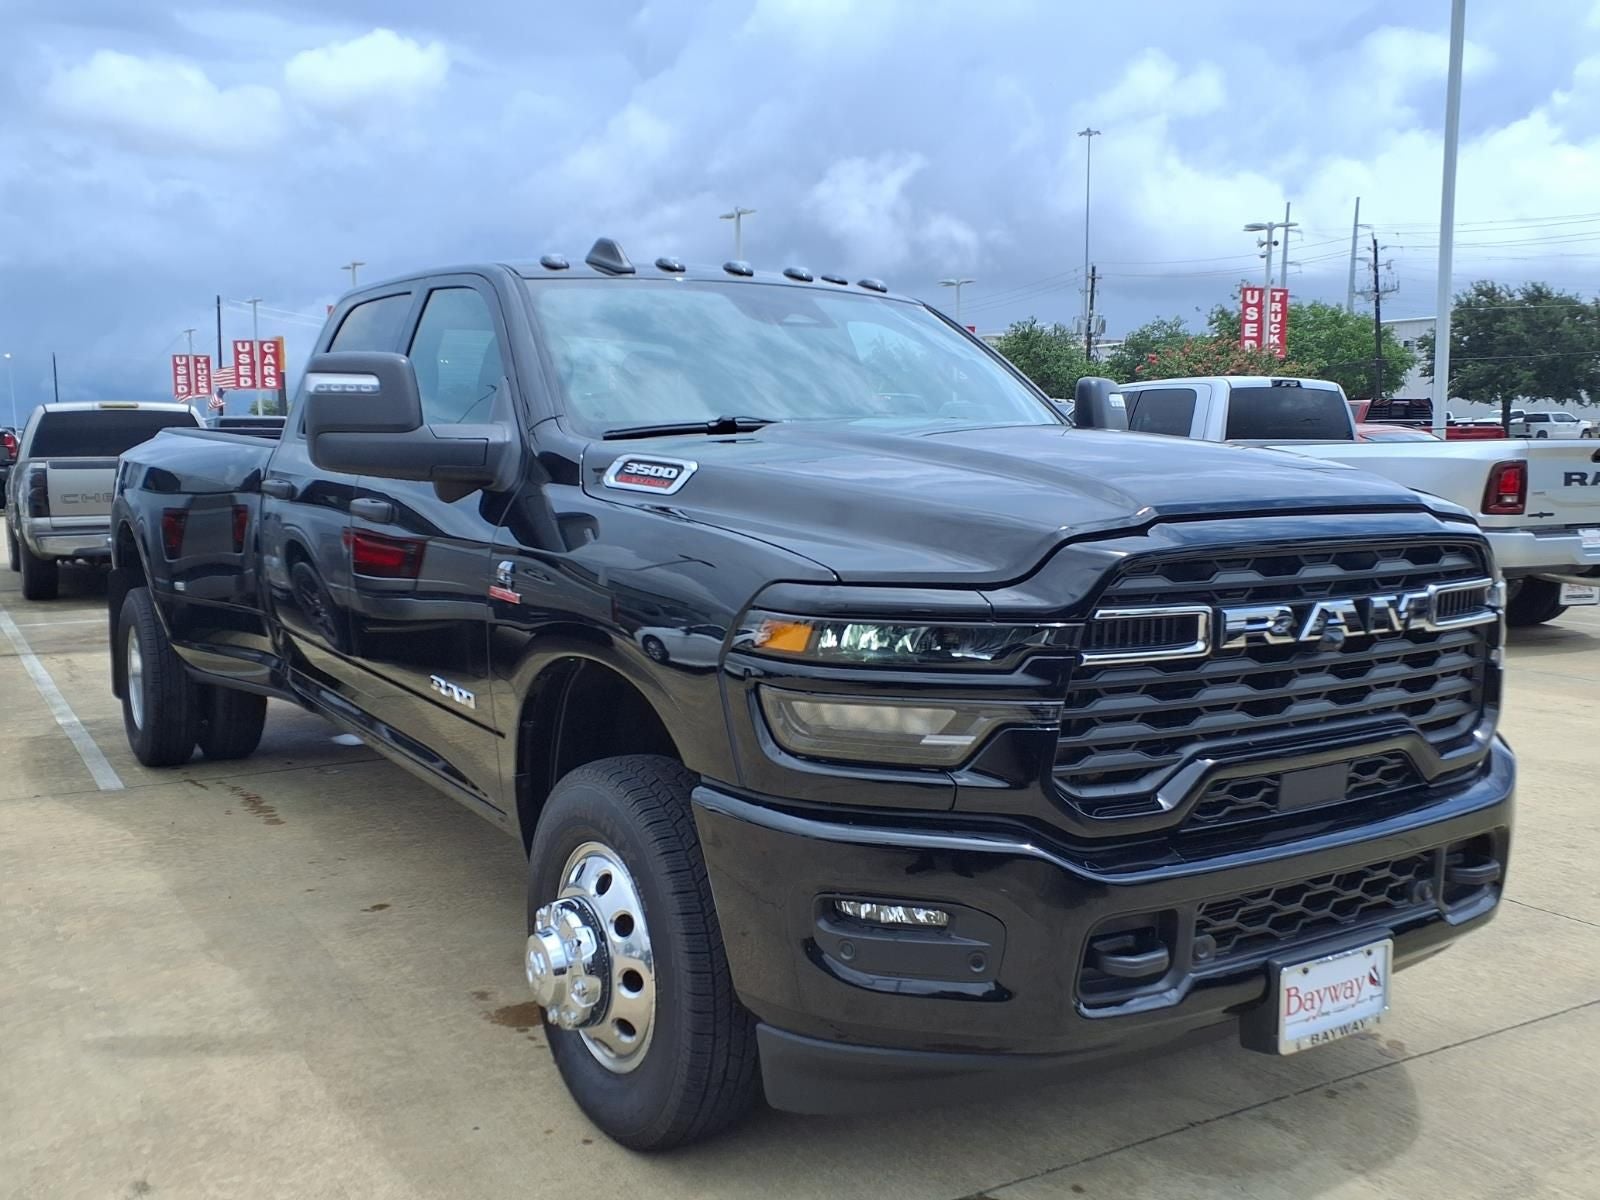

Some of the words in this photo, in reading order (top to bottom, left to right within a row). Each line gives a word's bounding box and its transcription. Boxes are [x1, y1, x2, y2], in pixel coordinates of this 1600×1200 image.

[175, 356, 188, 394] USED
[196, 356, 209, 394] TRUCKS
[236, 342, 252, 387] USED
[262, 342, 277, 387] CARS
[623, 462, 678, 479] 3500
[1220, 591, 1431, 649] RAM
[1286, 975, 1366, 1020] Bayway
[1311, 1017, 1368, 1045] BAYWAY
